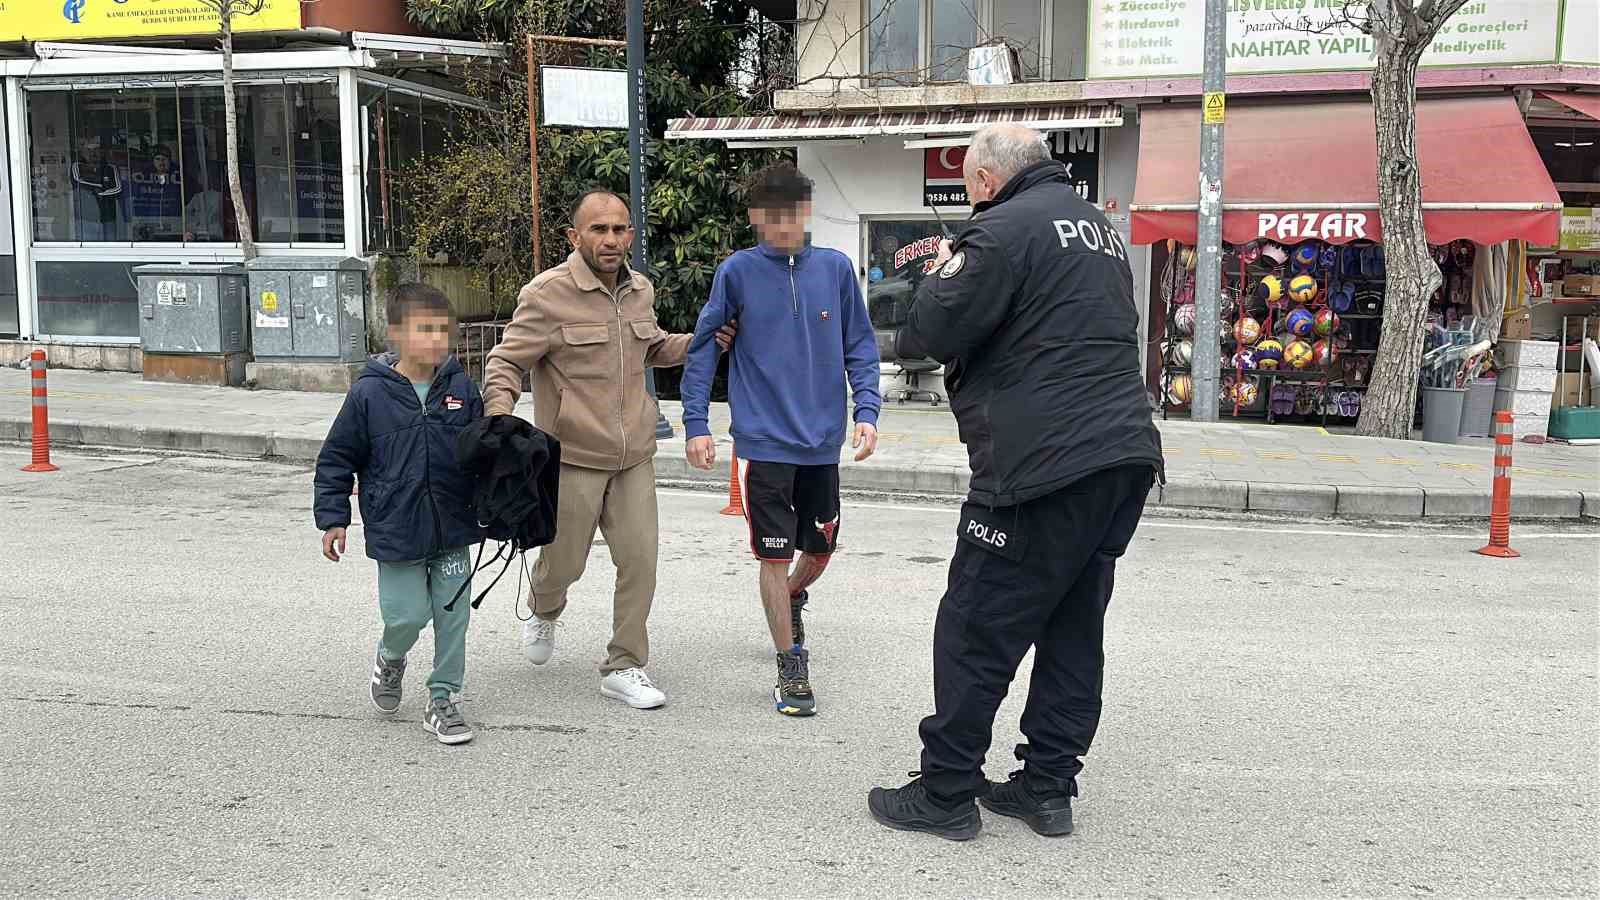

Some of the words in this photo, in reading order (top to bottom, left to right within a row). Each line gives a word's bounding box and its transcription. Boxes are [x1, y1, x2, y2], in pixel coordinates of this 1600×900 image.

[1119, 18, 1181, 30] Hırdavat
[1457, 20, 1529, 34] Gereçleri
[1118, 37, 1174, 49] Elektrik
[1433, 40, 1507, 55] Hediyelik
[1257, 212, 1367, 240] PAZAR
[1053, 219, 1125, 261] POLİS
[894, 235, 941, 269] ERKEK
[966, 519, 1007, 547] POLİS
